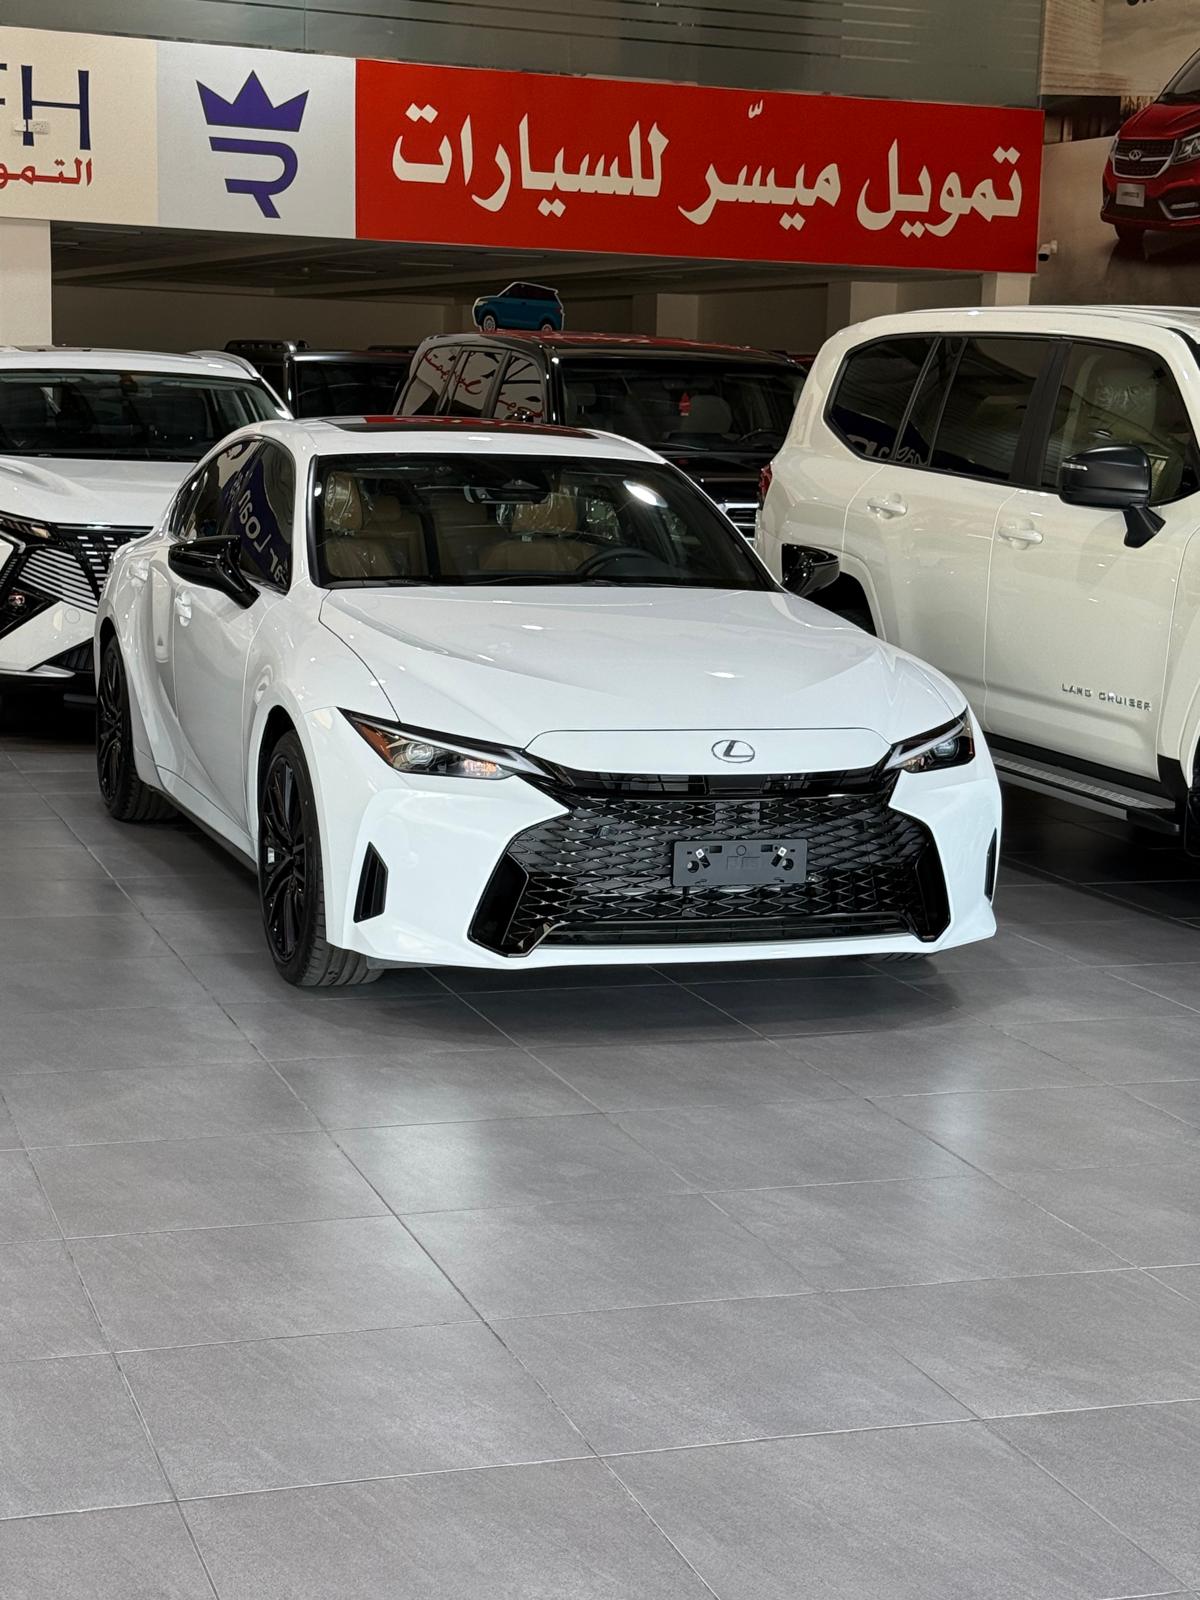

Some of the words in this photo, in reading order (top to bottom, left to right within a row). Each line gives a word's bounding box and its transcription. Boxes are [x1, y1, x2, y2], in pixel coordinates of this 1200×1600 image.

[392, 103, 669, 218] للسيارات
[678, 100, 841, 231] ميسّر
[856, 139, 1023, 238] تمويل
[1061, 683, 1092, 698] LAND
[1098, 692, 1152, 712] CRUISER
